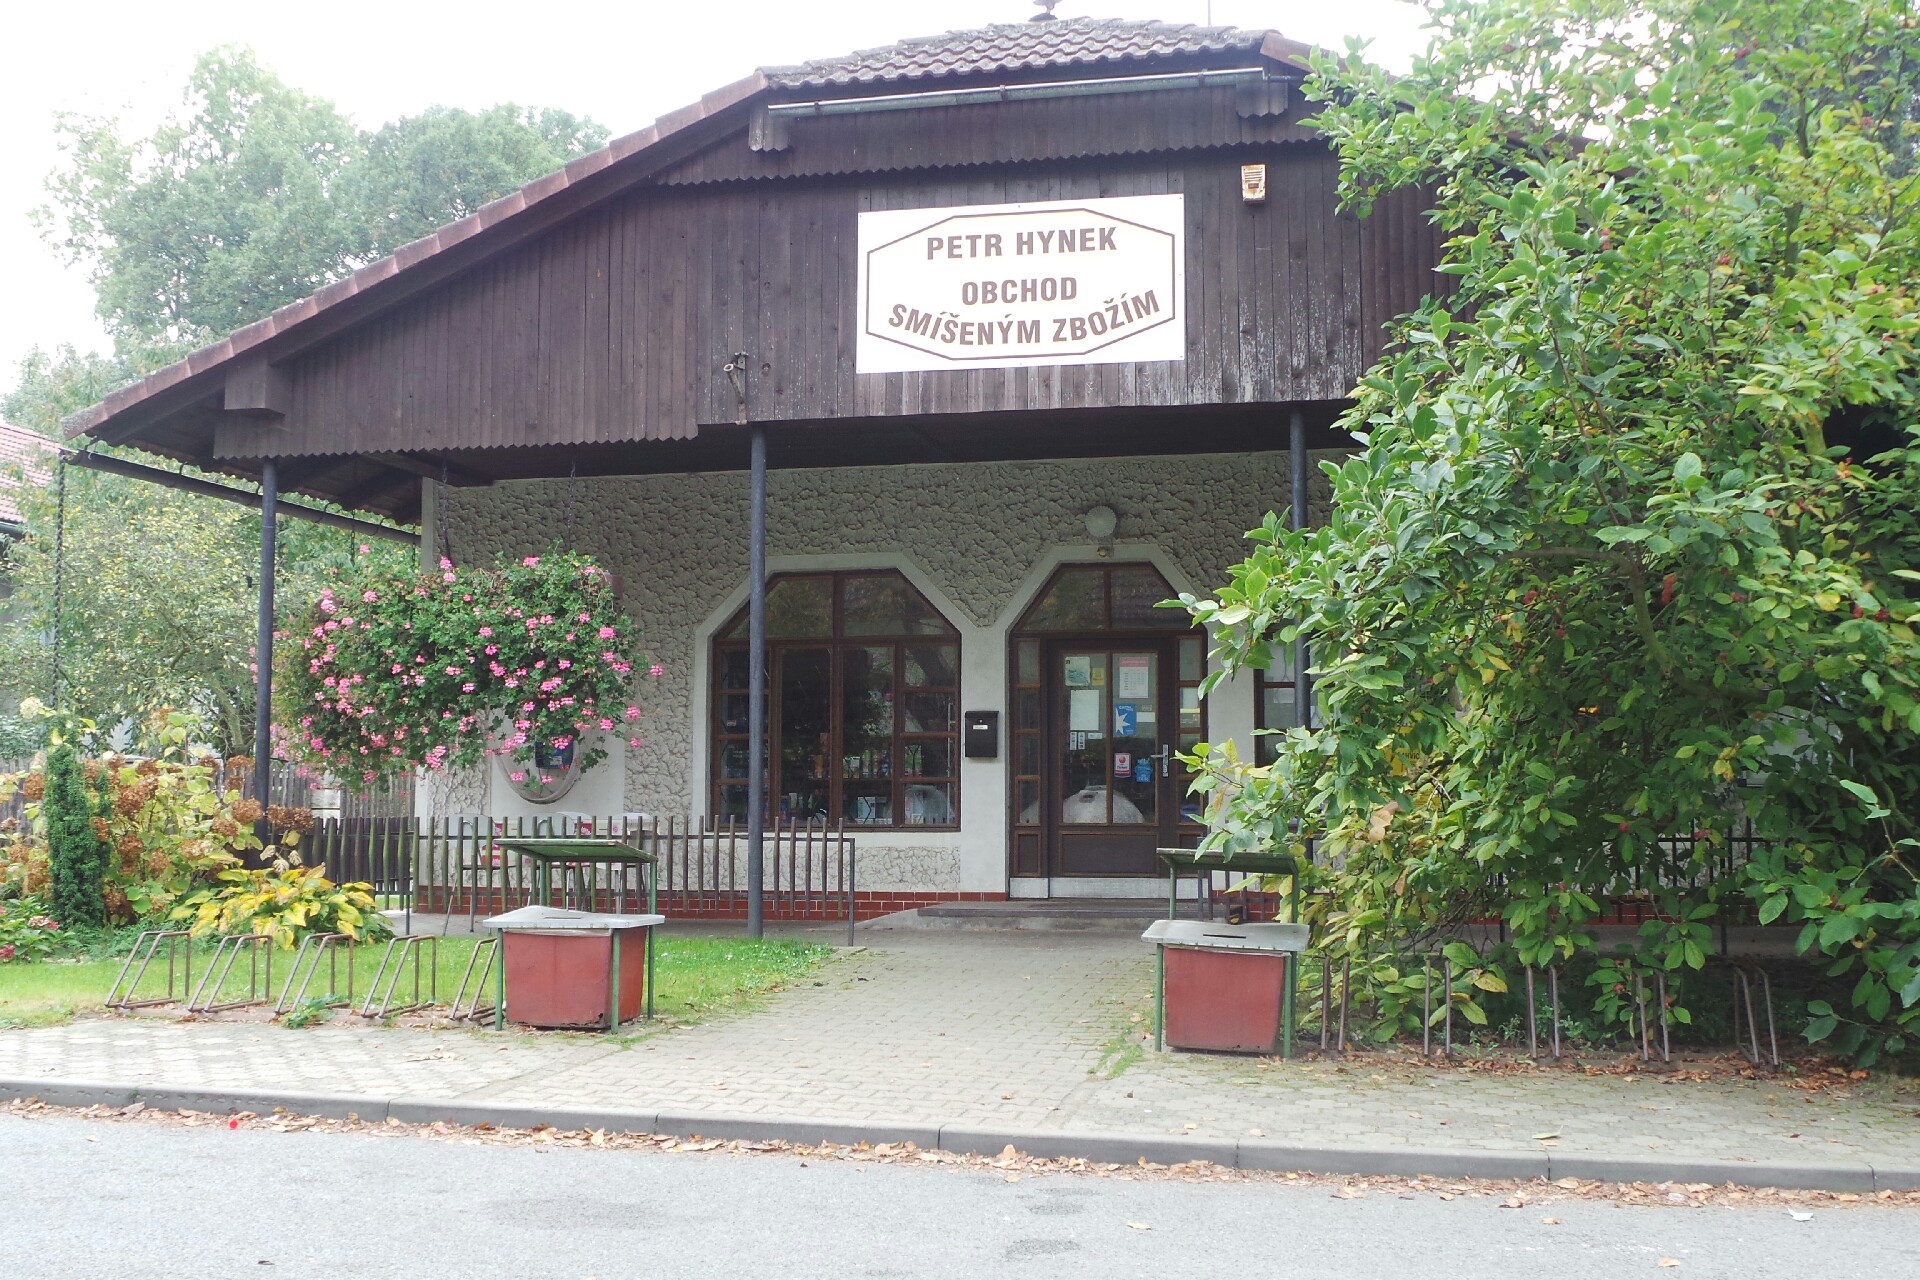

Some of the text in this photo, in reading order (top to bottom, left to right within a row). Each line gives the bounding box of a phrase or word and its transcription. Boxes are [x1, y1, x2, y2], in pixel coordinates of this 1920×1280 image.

[927, 227, 1117, 260] PETR HYNEK
[961, 277, 1077, 306] OBCHOD
[888, 289, 1161, 346] SMÍŠENÝM ZBOŽÍM
